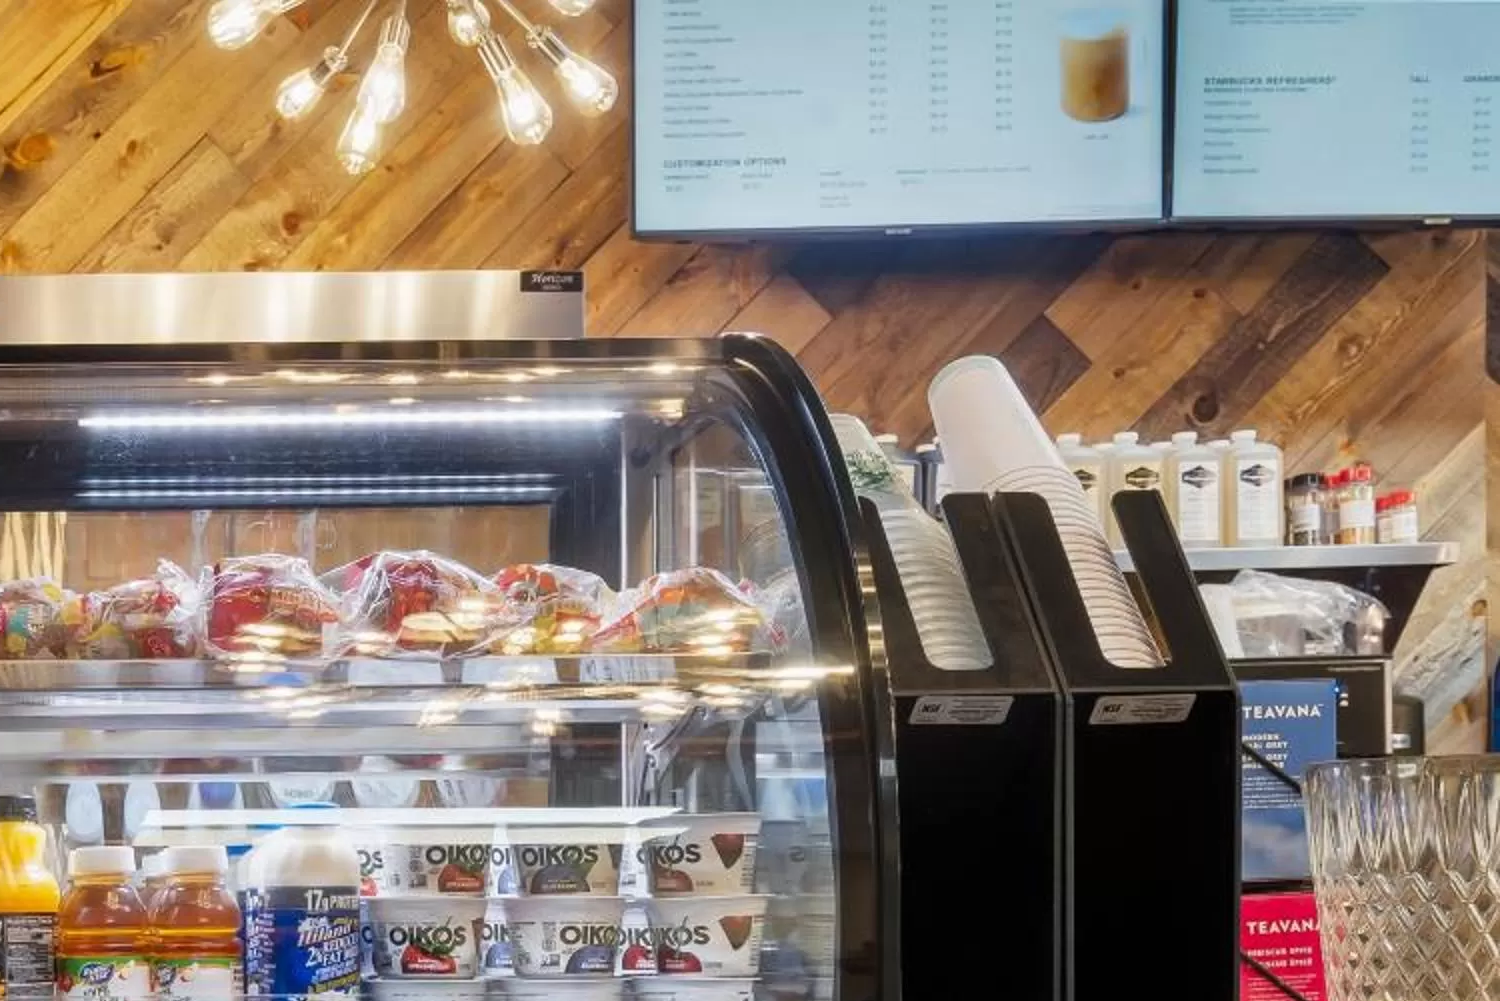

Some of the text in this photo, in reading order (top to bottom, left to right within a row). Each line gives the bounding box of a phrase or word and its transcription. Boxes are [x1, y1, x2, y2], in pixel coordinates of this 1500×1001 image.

[1242, 704, 1322, 720] TEAVANA
[521, 846, 599, 867] OIKOS
[389, 924, 467, 947] OIKOS
